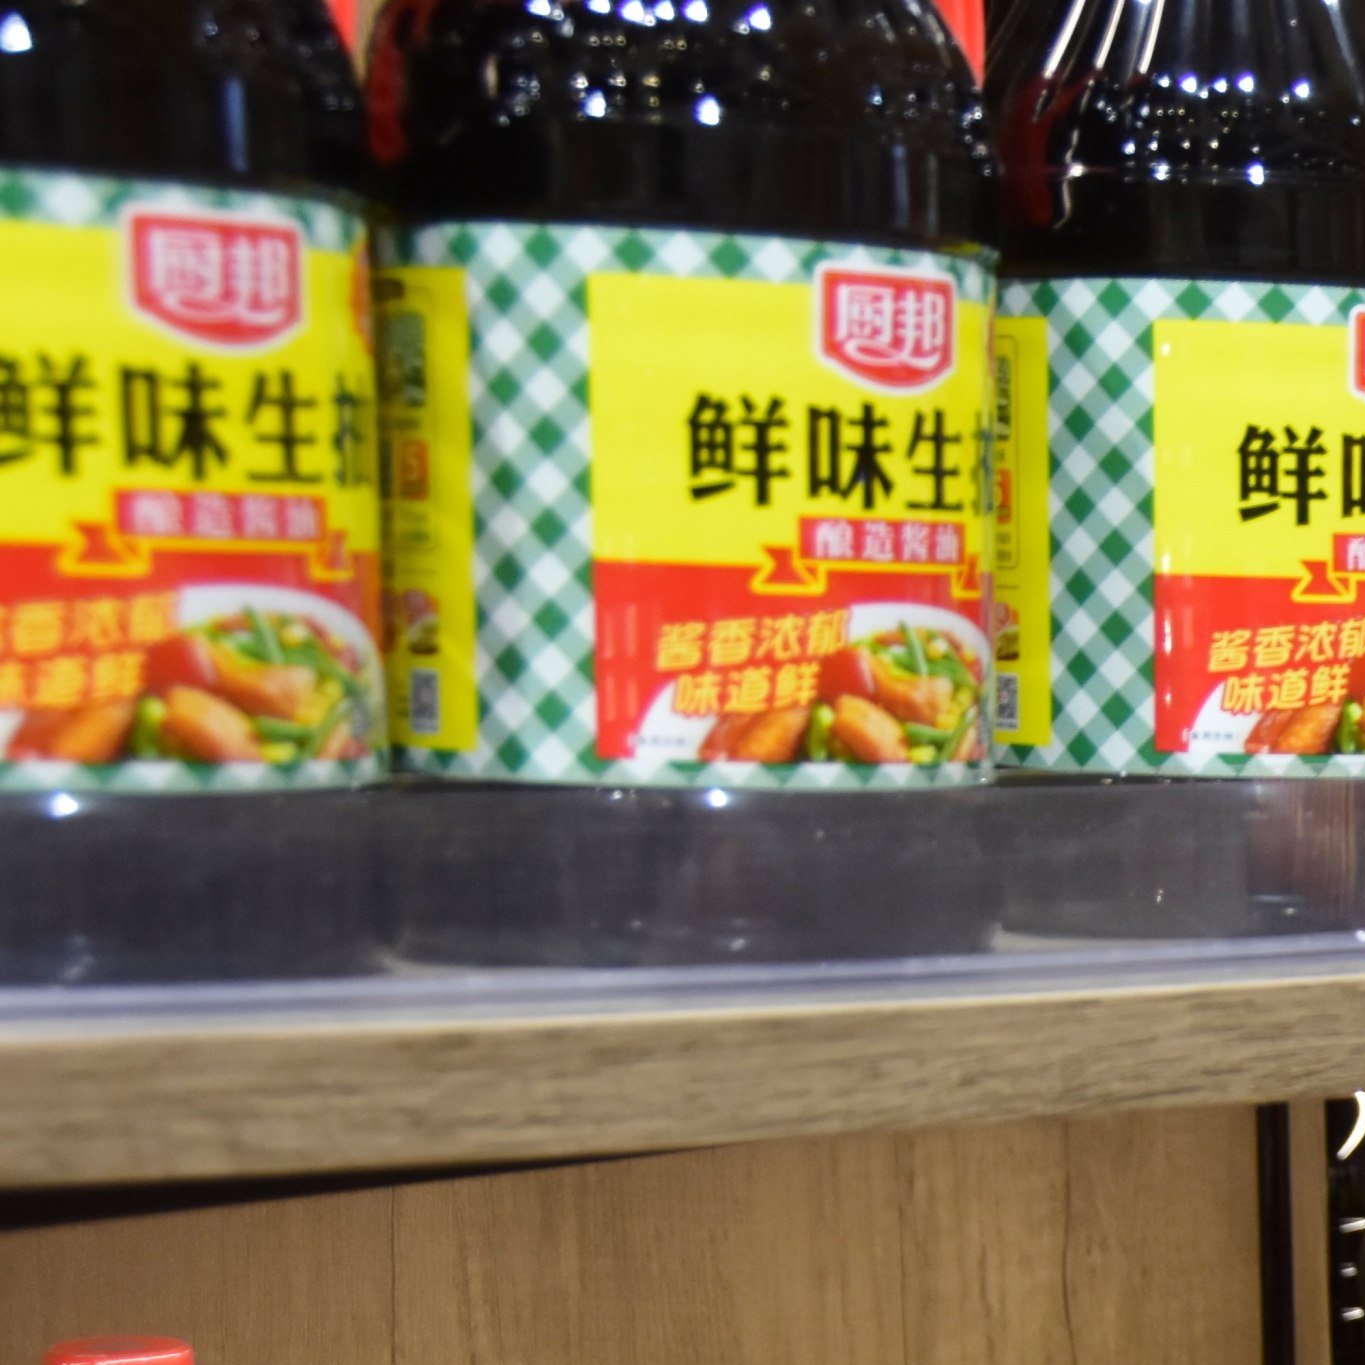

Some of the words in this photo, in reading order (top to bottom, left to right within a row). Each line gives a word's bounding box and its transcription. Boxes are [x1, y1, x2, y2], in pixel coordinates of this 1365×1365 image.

[836, 283, 946, 368] 厨邦
[656, 608, 851, 671] 酱香浓郁
[673, 661, 821, 718] 味道鲜
[1221, 663, 1353, 716] 味道鲜
